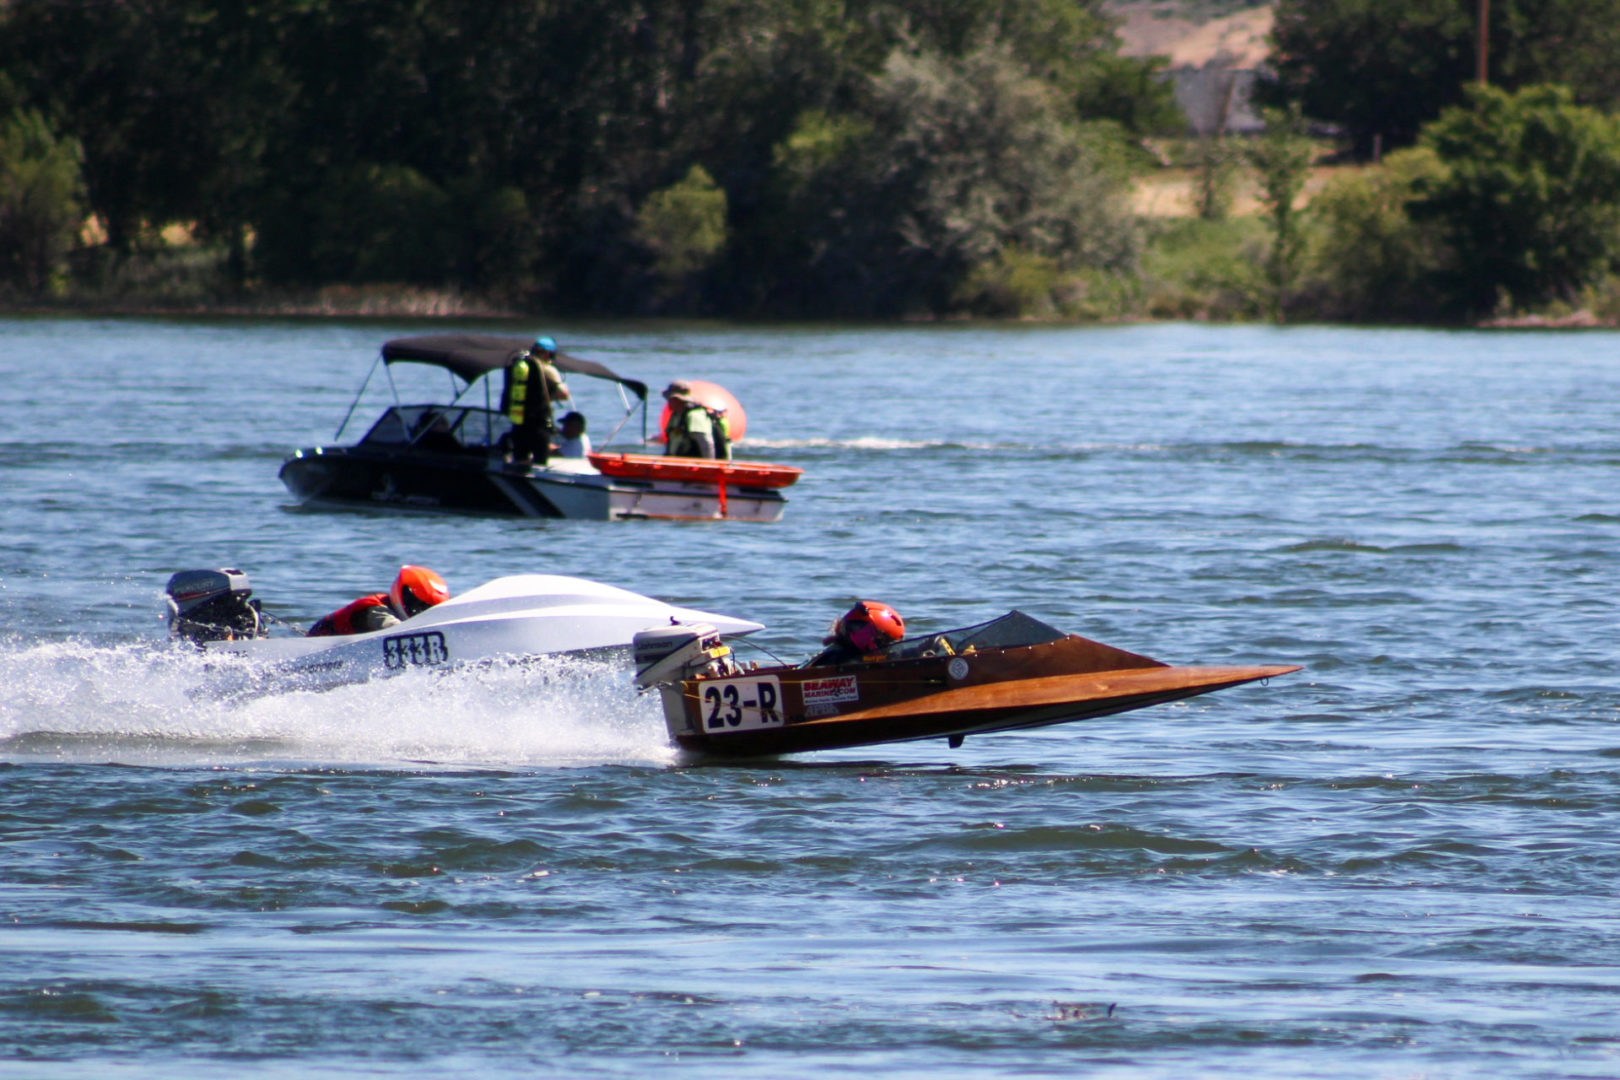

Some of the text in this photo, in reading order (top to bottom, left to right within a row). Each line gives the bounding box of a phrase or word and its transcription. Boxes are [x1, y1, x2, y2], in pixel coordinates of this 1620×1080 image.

[384, 631, 448, 668] 333R
[804, 678, 854, 691] SEAWAY
[705, 682, 779, 728] 23-R
